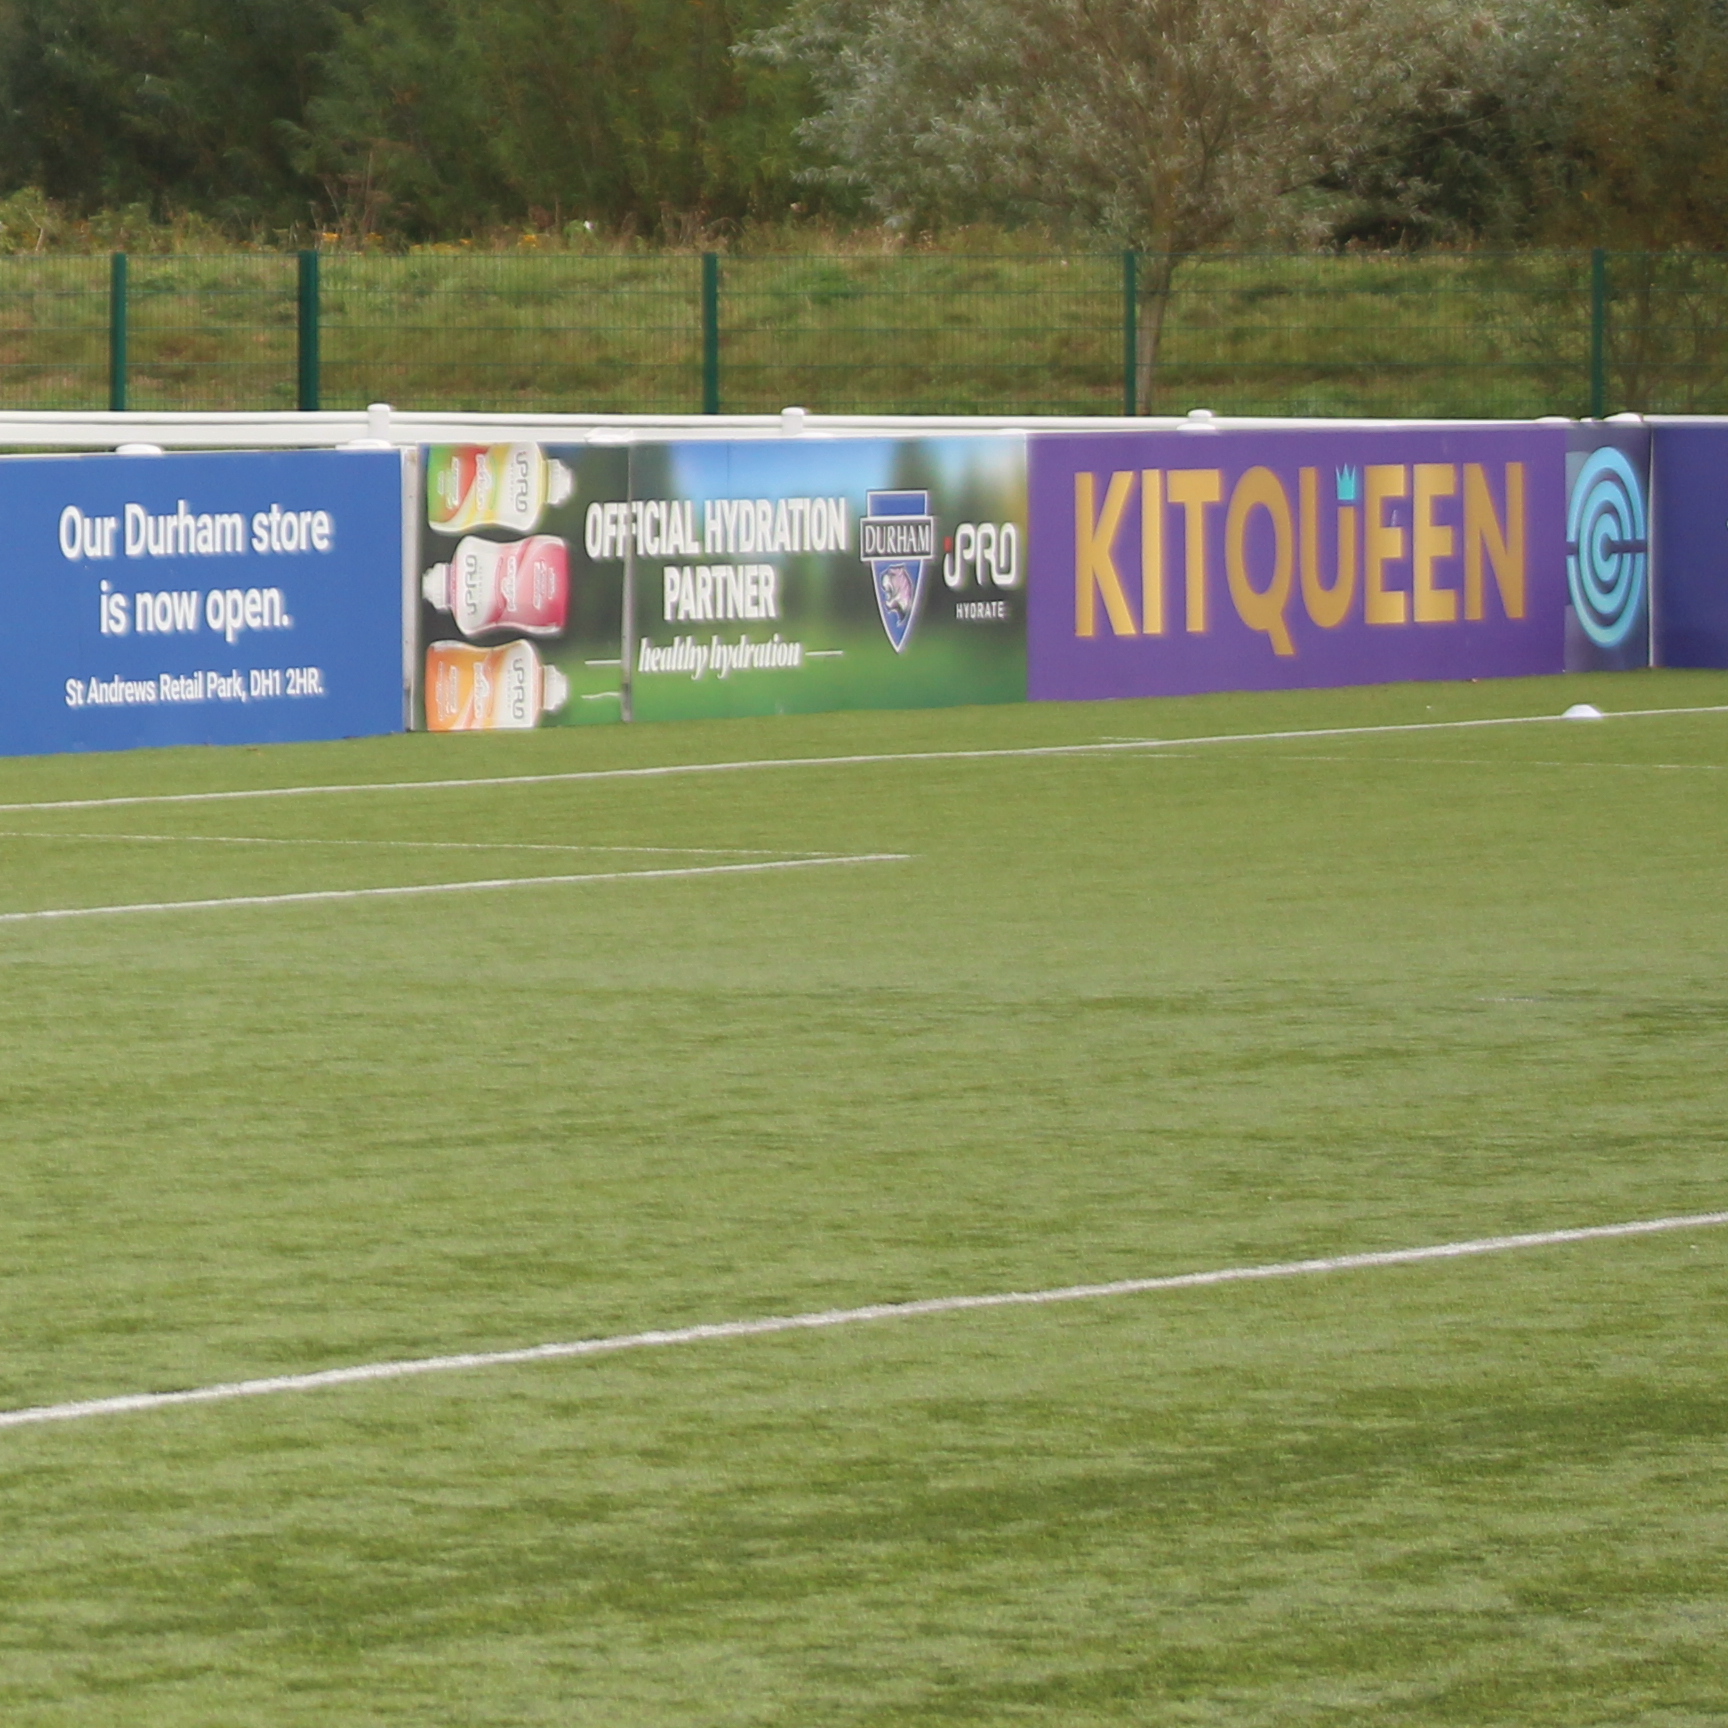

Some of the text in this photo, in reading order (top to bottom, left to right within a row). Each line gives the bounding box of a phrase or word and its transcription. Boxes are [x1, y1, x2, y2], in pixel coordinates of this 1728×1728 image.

[59, 498, 331, 559] Our Durham store
[585, 497, 847, 559] OFFICIAL HYDRATION
[864, 524, 930, 554] DURHAM
[1074, 461, 1525, 656] KITQUEEN
[100, 579, 290, 643] is now open.
[663, 564, 777, 621] PARTNER
[956, 600, 1005, 620] HYDRATE
[638, 633, 801, 680] healthy hydration
[65, 667, 323, 712] St Andrews Retail Park, DH1 2HR.
